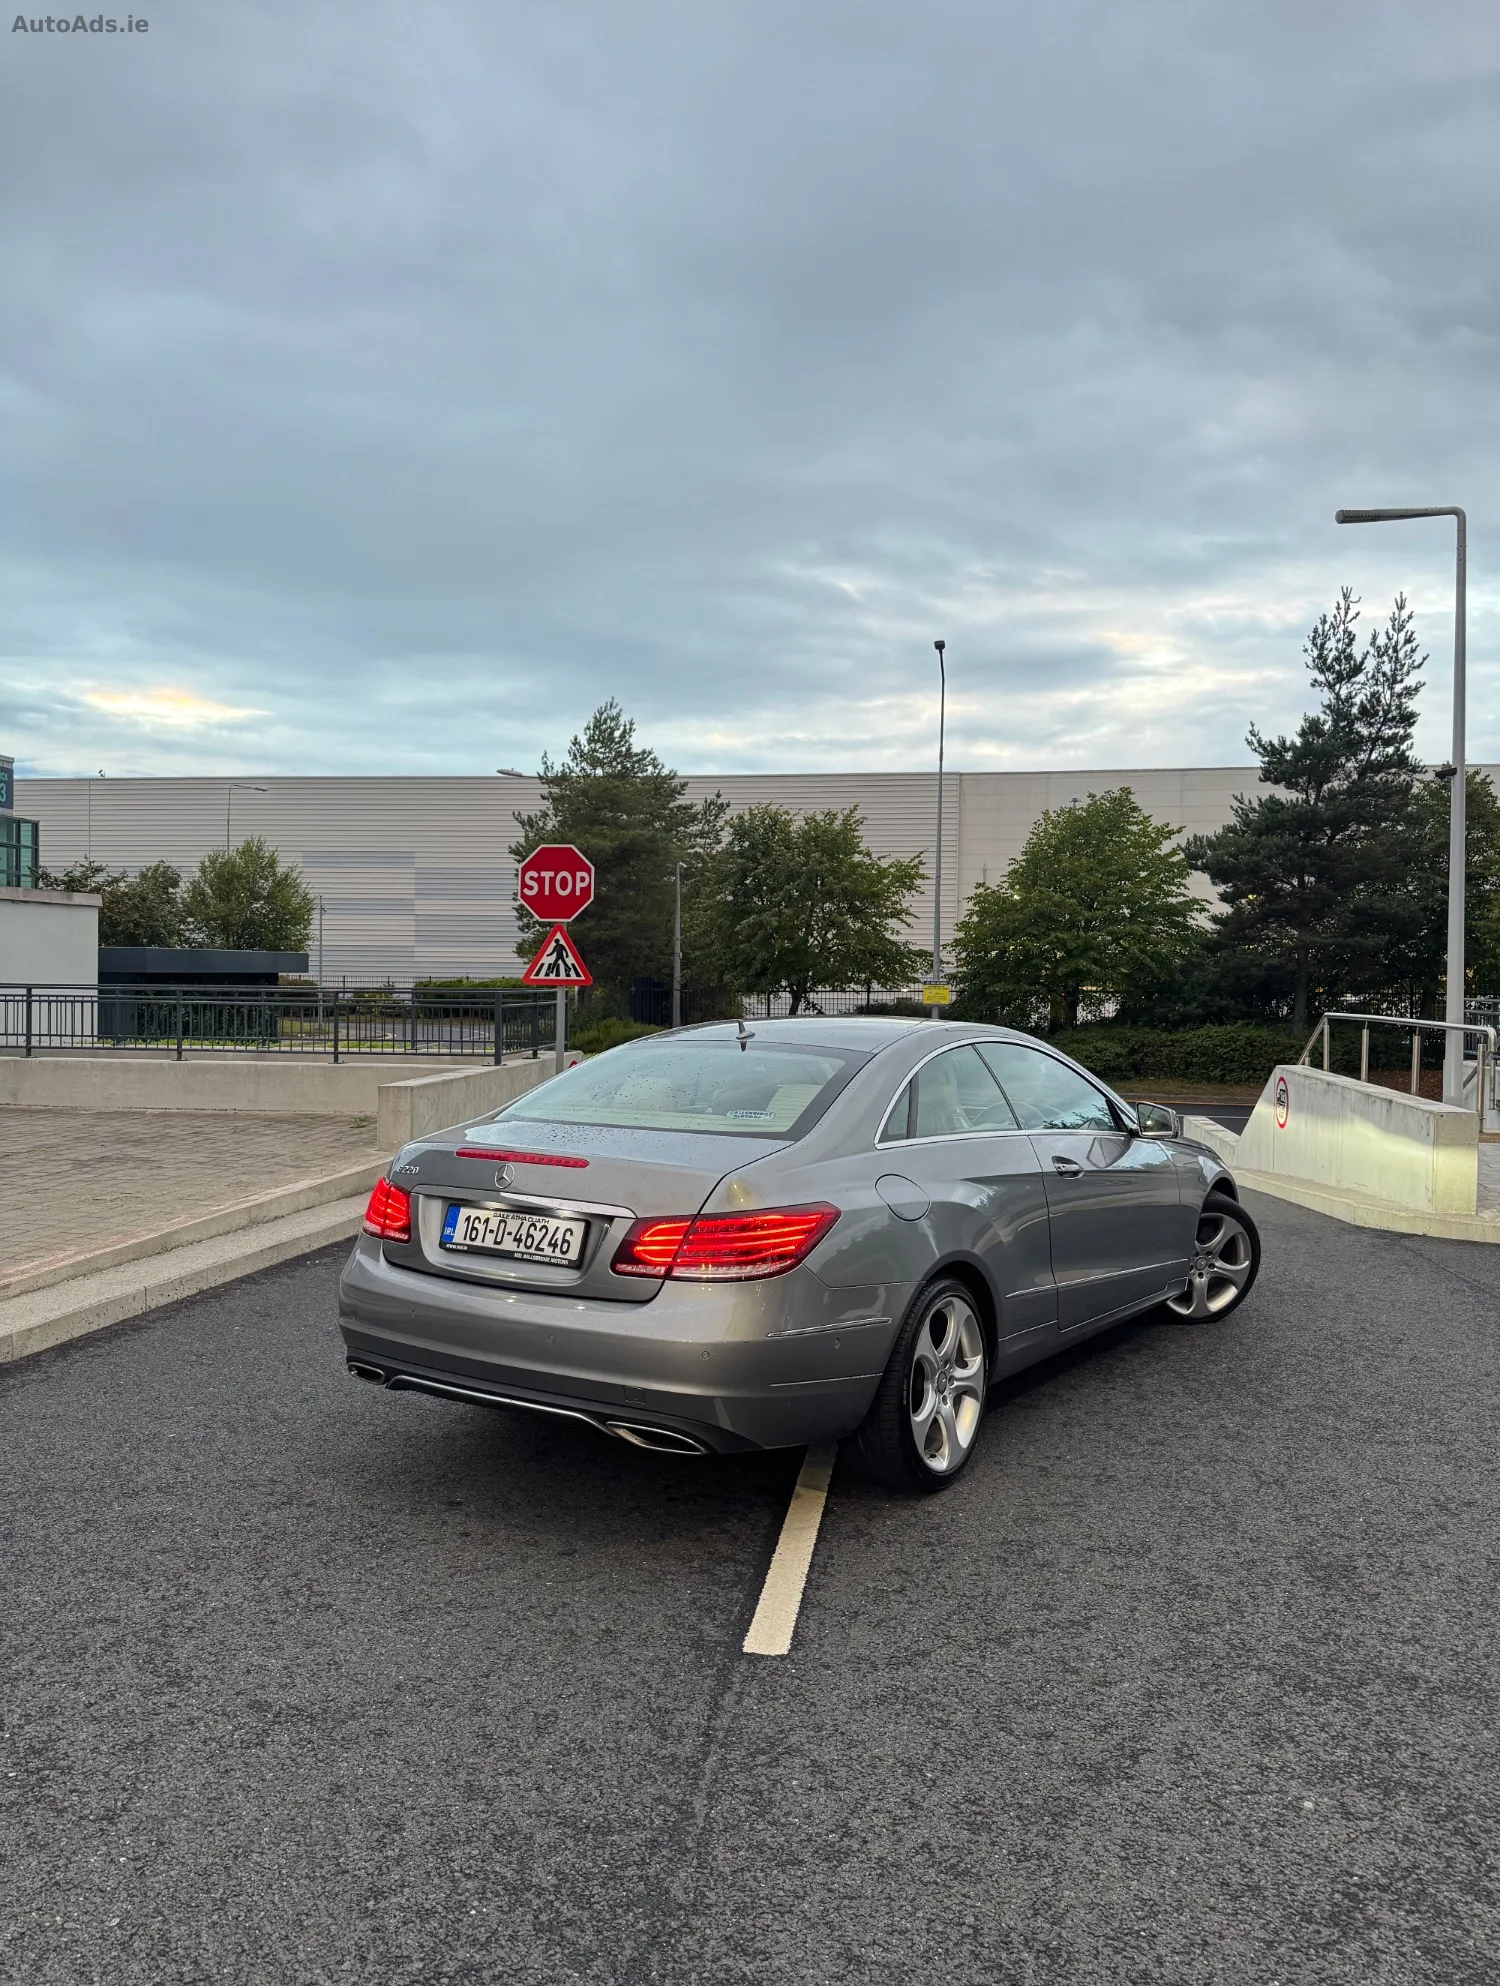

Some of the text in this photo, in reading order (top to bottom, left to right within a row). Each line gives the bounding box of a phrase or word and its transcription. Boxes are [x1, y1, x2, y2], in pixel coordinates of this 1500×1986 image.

[522, 870, 590, 896] STOP
[443, 1226, 455, 1236] IRL
[463, 1214, 574, 1256] 161-D-46246
[550, 1257, 569, 1265] MOTORS
